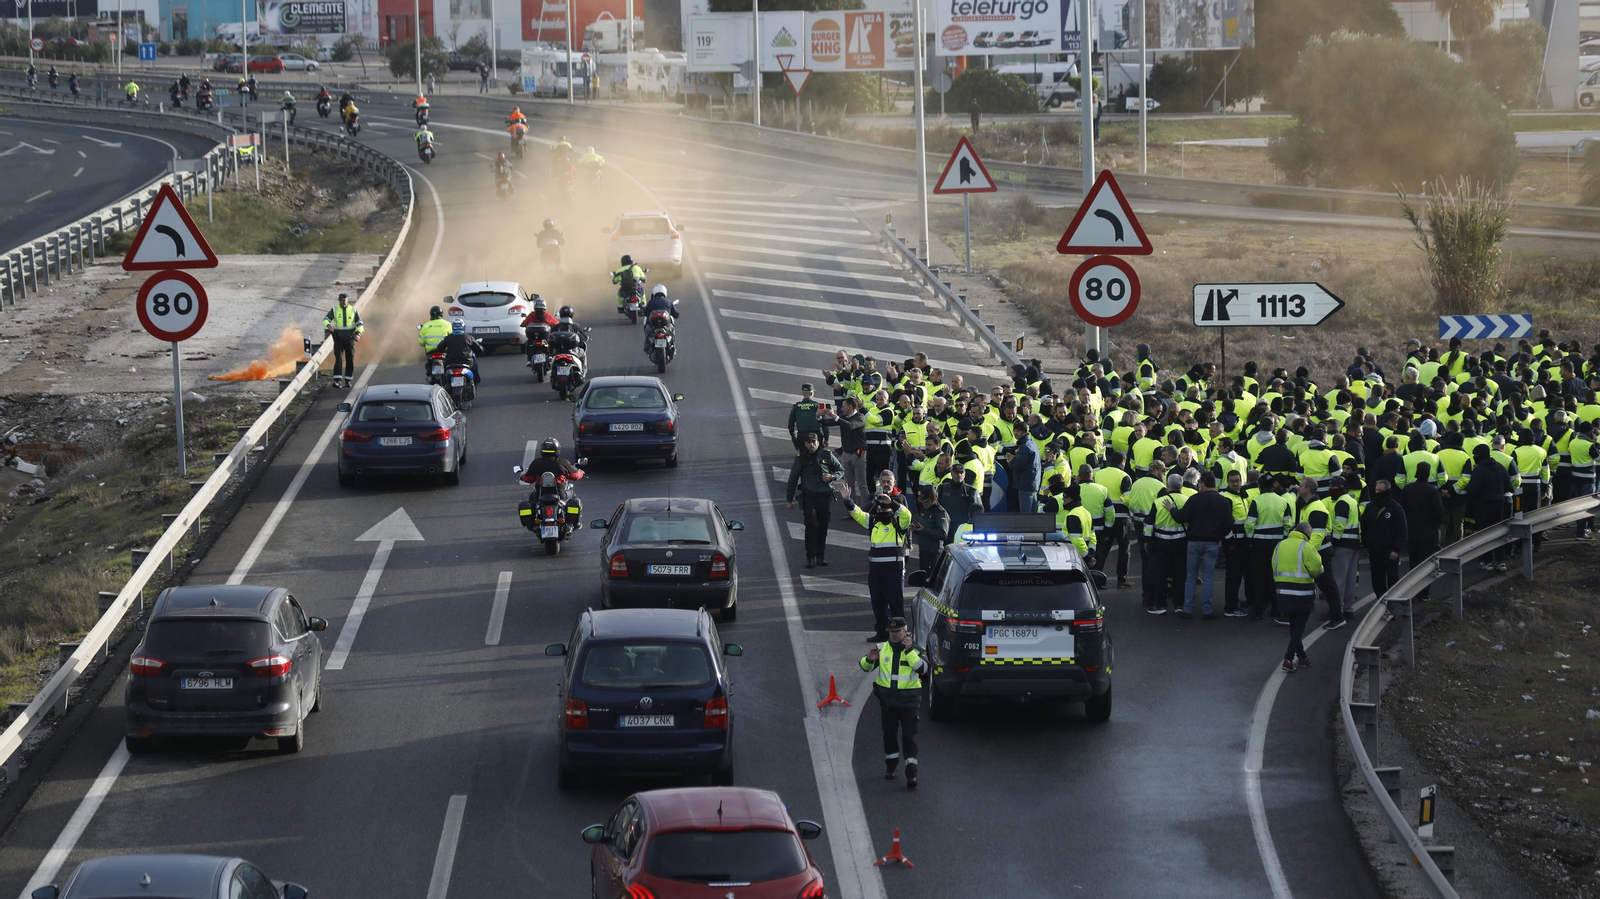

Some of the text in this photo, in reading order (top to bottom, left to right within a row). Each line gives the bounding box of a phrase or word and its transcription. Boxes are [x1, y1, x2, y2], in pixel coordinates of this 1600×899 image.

[291, 3, 344, 14] CLEMENTE
[890, 19, 914, 38] 2,49
[811, 32, 841, 41] BURGER
[812, 42, 841, 54] KING
[1085, 277, 1126, 301] 80
[152, 291, 193, 317] 80
[1257, 294, 1306, 318] 1113
[652, 565, 689, 574] 5079 FRR
[994, 629, 1010, 637] PGC
[968, 642, 980, 650] 062
[187, 678, 232, 688] 6796 HLM
[627, 715, 672, 726] 4037 CNK
